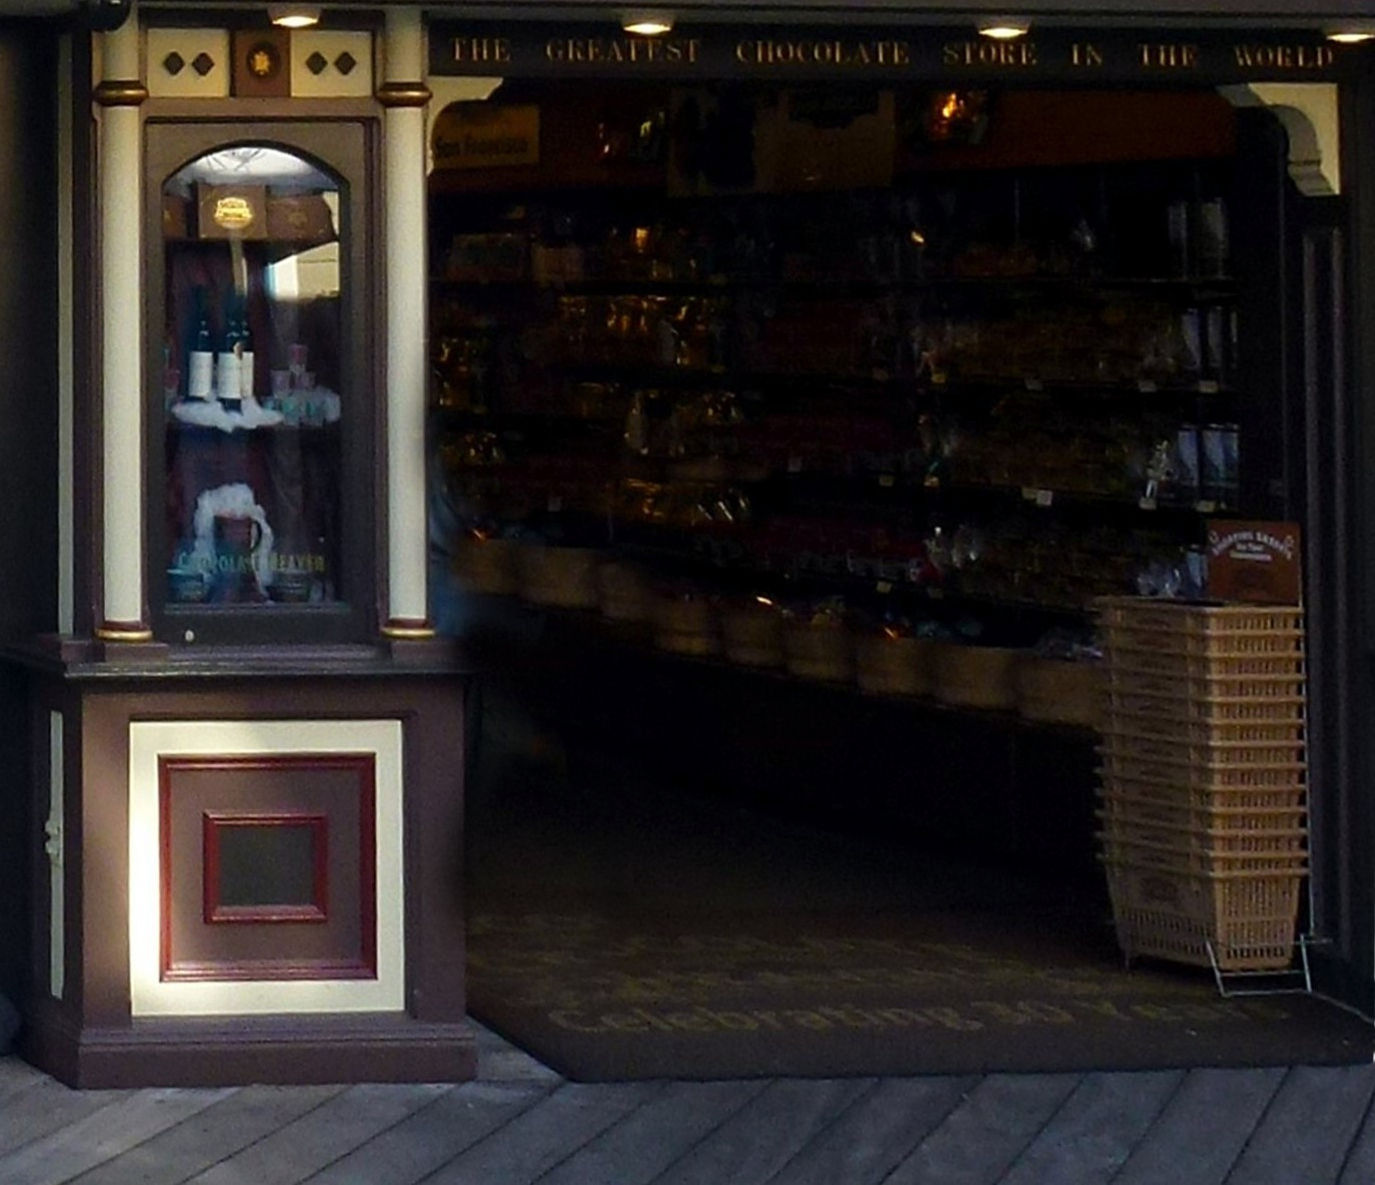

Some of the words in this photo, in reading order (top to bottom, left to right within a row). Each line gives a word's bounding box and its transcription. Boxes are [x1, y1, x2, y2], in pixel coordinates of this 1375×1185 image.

[452, 37, 511, 63] THE
[545, 37, 701, 64] GREATEST
[736, 40, 910, 66] CHOCOLATE
[943, 42, 1038, 66] STORE
[1072, 43, 1104, 66] IN
[1140, 43, 1197, 68] THE
[1234, 44, 1335, 69] WORLD
